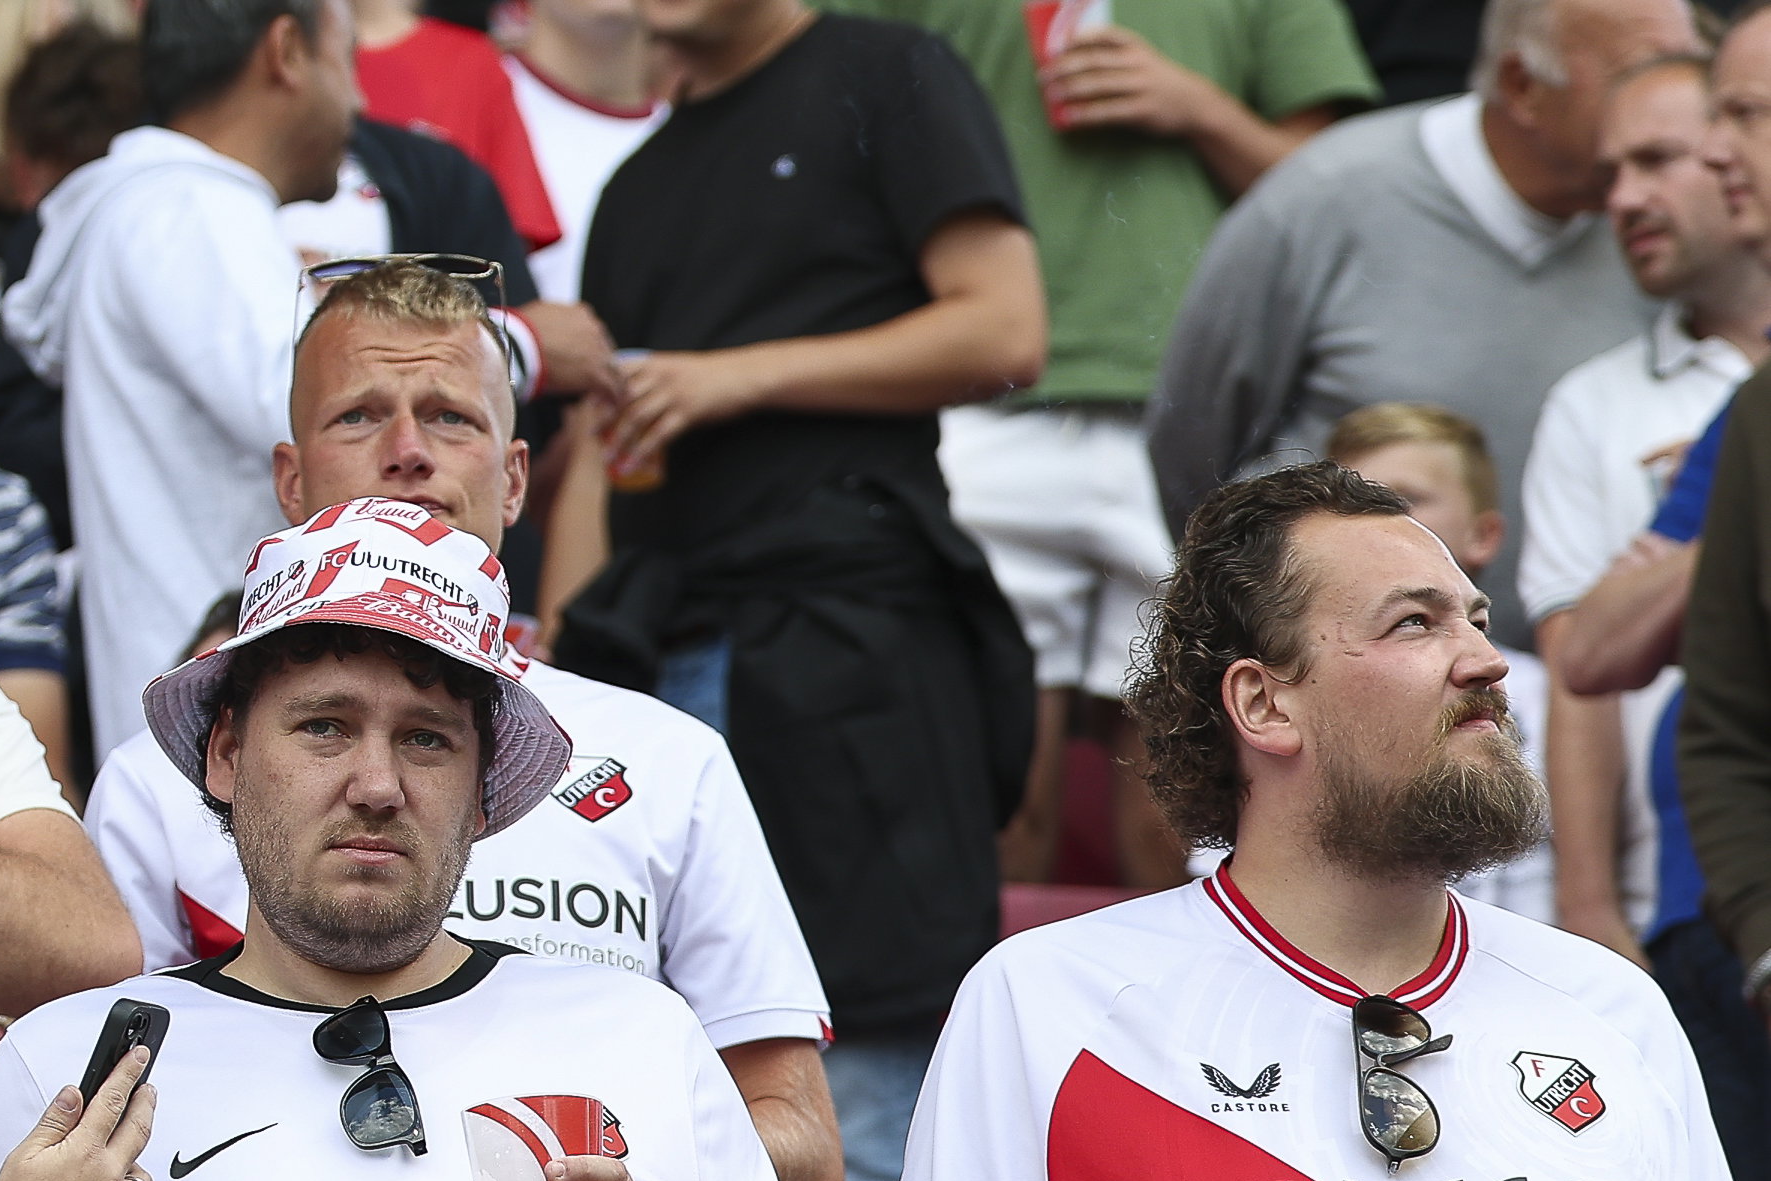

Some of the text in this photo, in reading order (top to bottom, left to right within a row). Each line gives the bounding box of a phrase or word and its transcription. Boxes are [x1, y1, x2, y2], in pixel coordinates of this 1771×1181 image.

[320, 551, 349, 571] FC
[350, 550, 464, 603] UUUTRECHT
[557, 757, 624, 807] UTRECHT
[594, 786, 617, 809] C
[446, 878, 647, 942] USION
[498, 932, 645, 976] nsformation
[1530, 1058, 1546, 1078] F
[1533, 1062, 1590, 1113] UTRECHT
[1210, 1102, 1291, 1113] CASTORE
[1569, 1095, 1594, 1119] C
